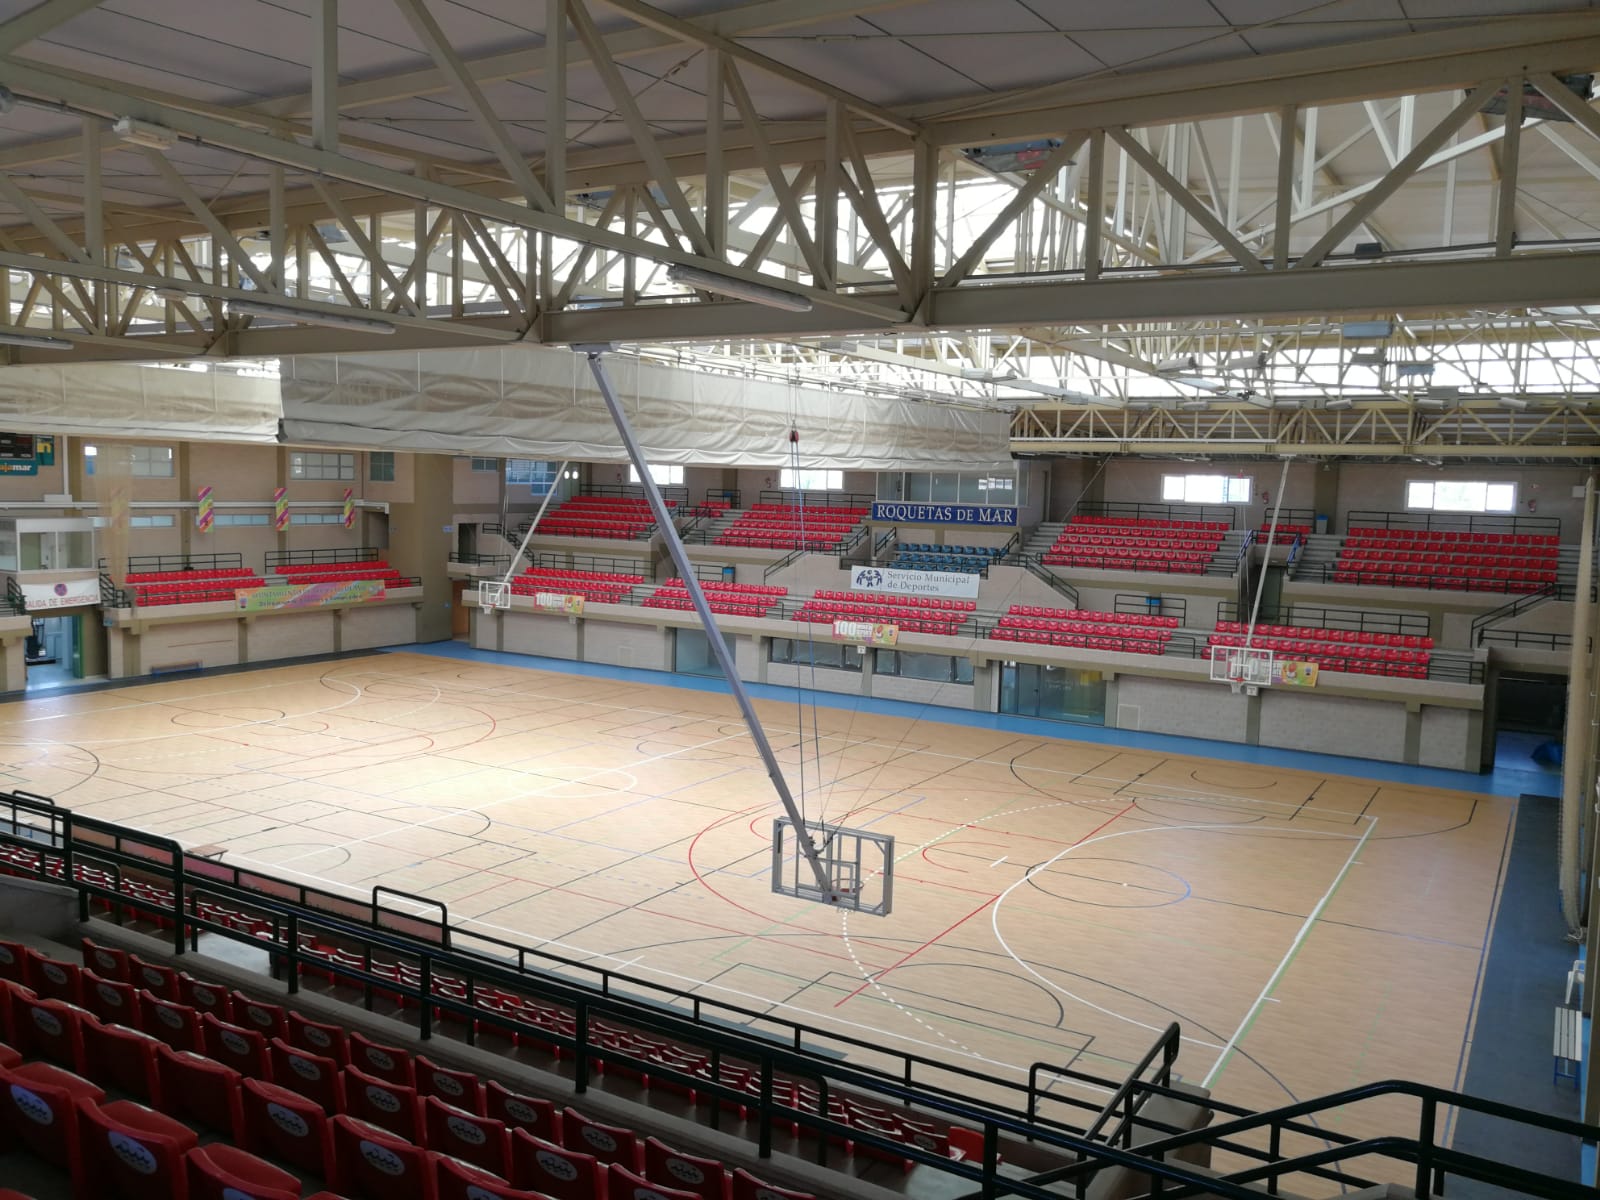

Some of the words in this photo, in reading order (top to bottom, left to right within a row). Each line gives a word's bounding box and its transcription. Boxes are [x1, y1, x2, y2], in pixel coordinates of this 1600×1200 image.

[877, 504, 952, 521] ROQUETAS
[957, 510, 973, 521] DE
[978, 508, 1013, 523] MAR
[887, 571, 922, 582] Servicio
[924, 573, 970, 585] Municipal
[887, 581, 897, 589] de
[900, 581, 939, 592] Deportes
[834, 620, 857, 636] 100
